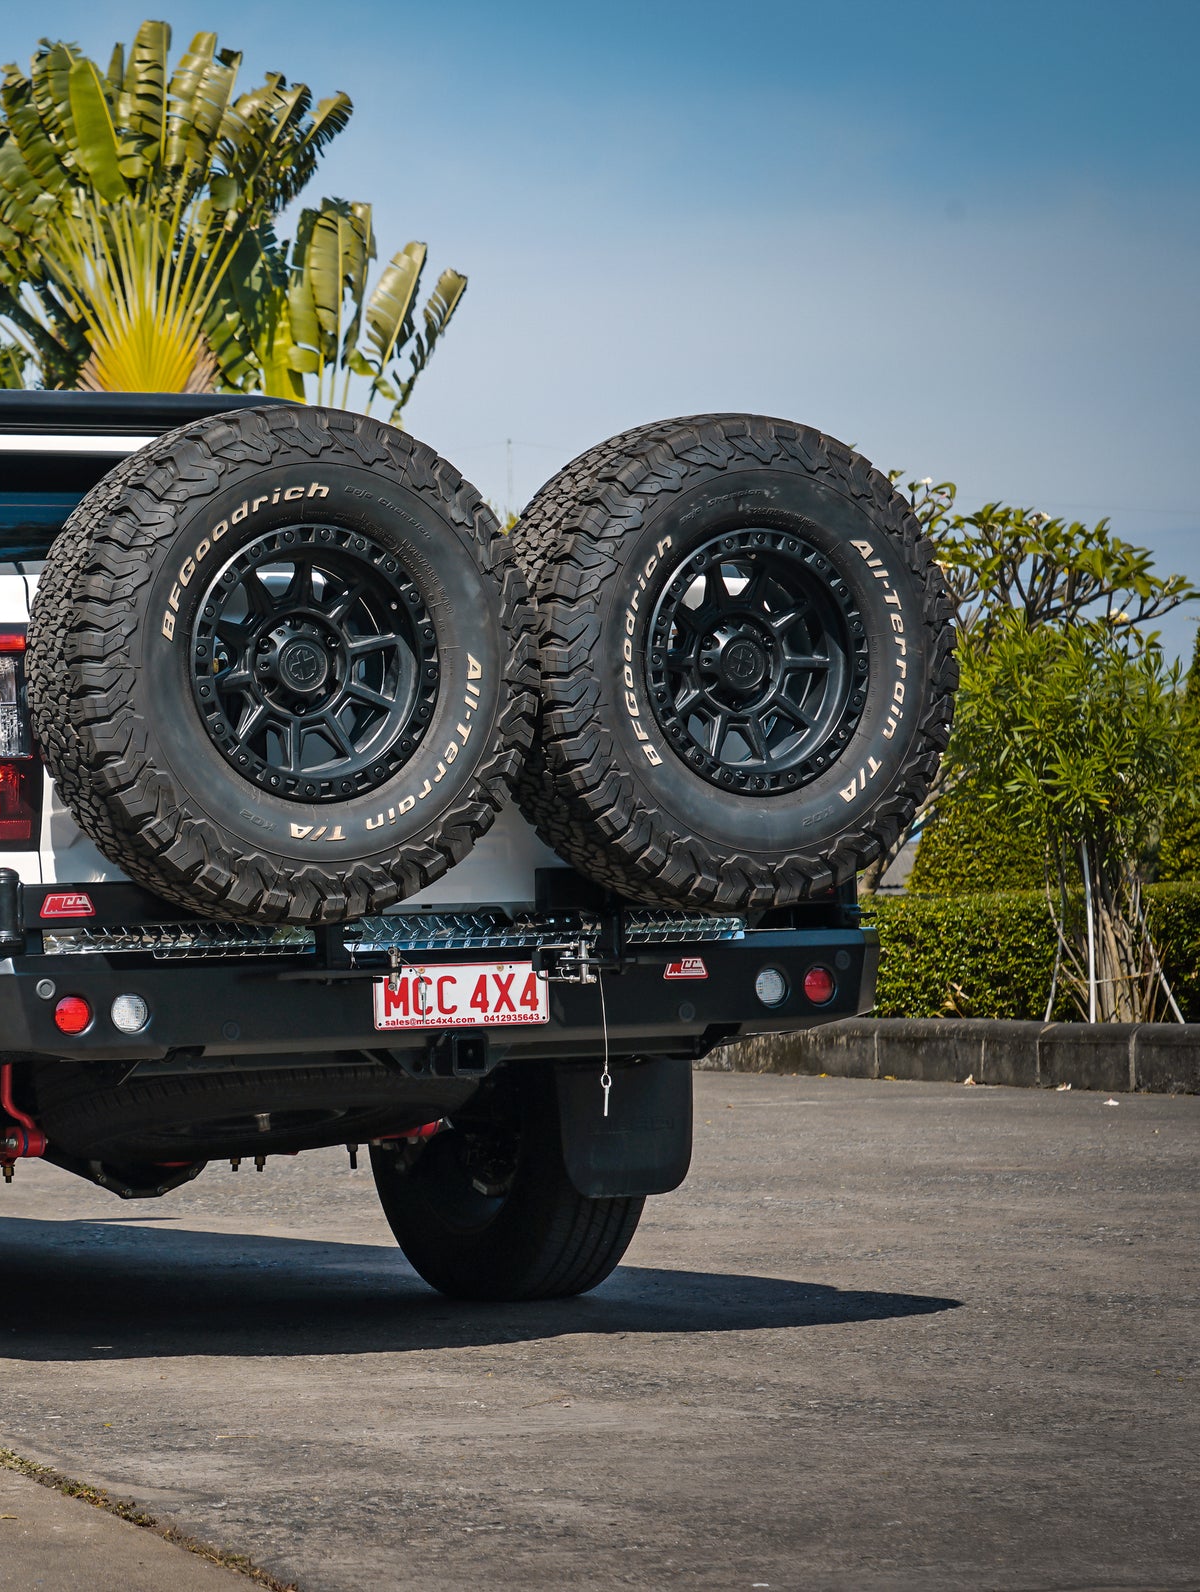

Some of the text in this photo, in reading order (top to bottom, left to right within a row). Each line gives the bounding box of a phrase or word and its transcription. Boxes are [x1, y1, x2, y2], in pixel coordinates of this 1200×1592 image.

[161, 482, 330, 642] BFGoodrich
[623, 534, 673, 767] BFGoodrich
[839, 539, 907, 803] All-Terrain T/A
[289, 652, 484, 842] All-Terrain T/A
[384, 972, 540, 1018] MCC 4X4
[384, 1013, 540, 1027] sales@mcc4x4.com 0412935643
